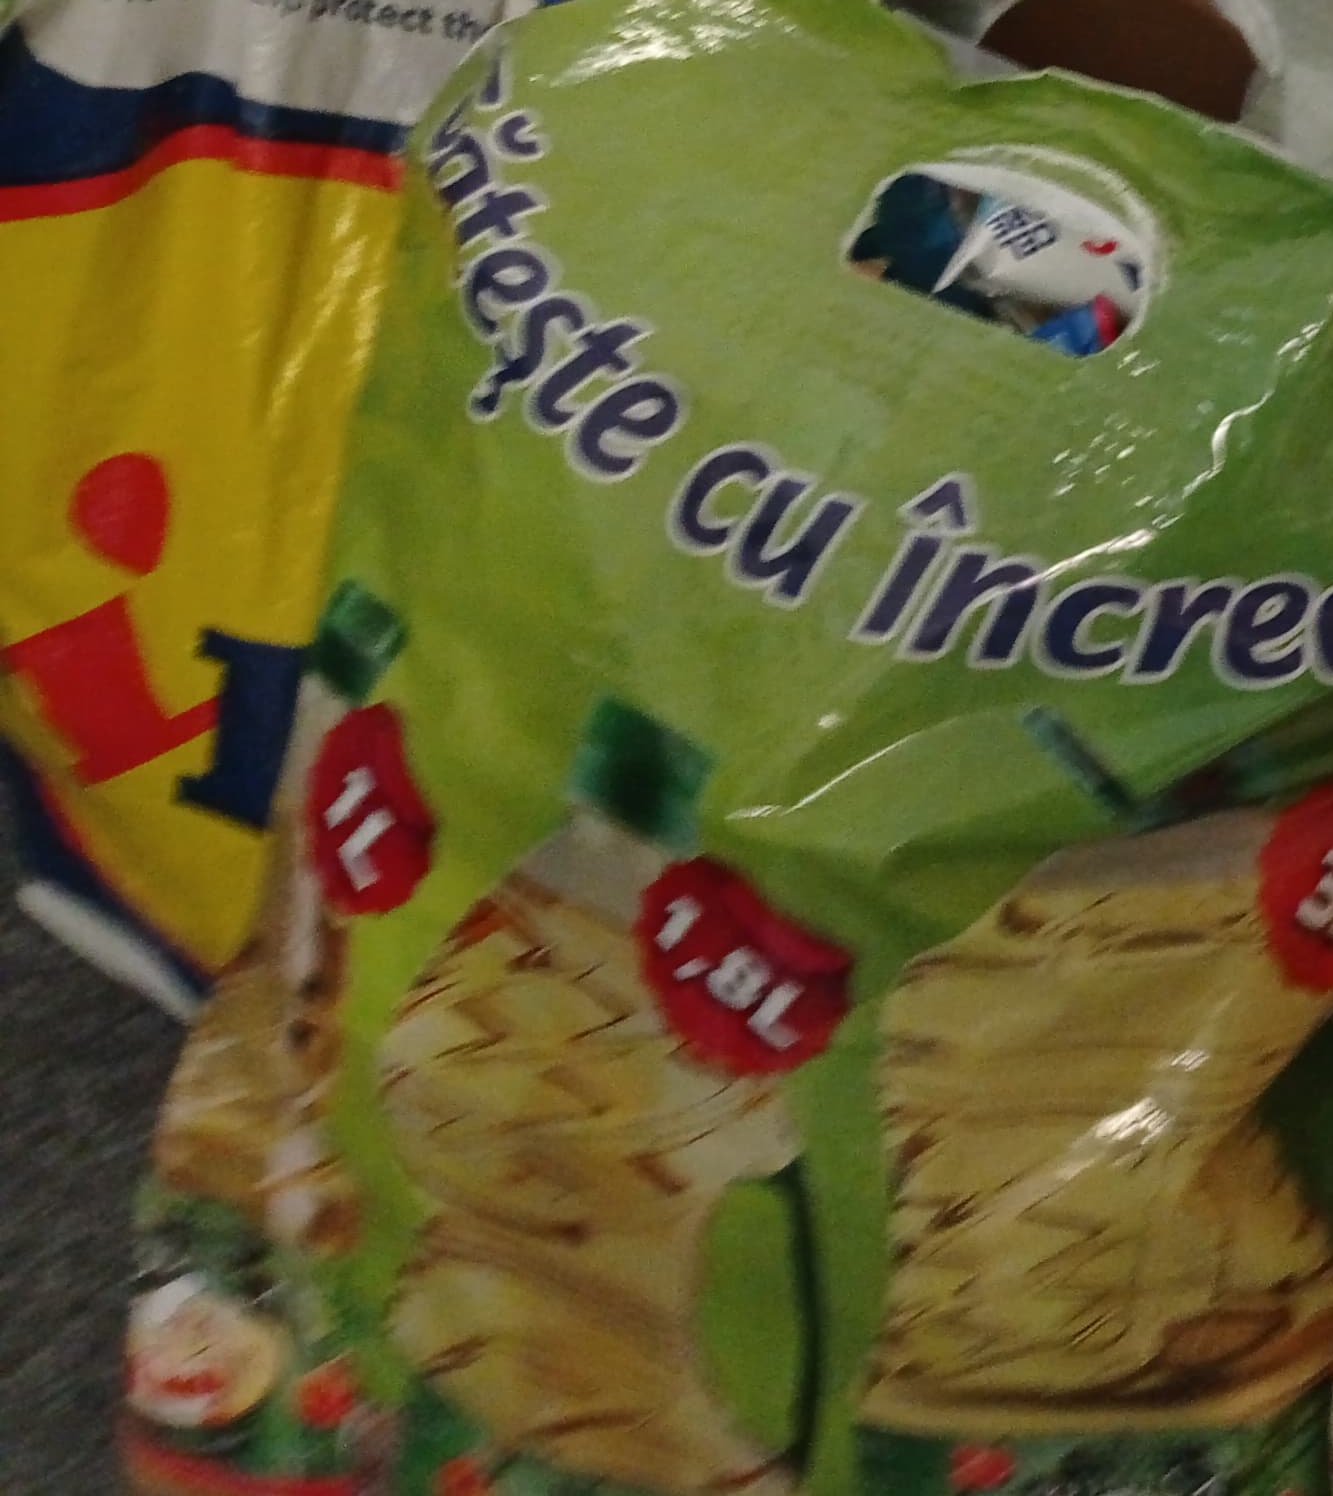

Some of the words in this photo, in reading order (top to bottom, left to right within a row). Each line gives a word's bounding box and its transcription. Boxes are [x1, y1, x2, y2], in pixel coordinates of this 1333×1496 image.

[674, 446, 859, 603] cu
[322, 762, 398, 893] 1L
[654, 892, 807, 1052] 1,8L
